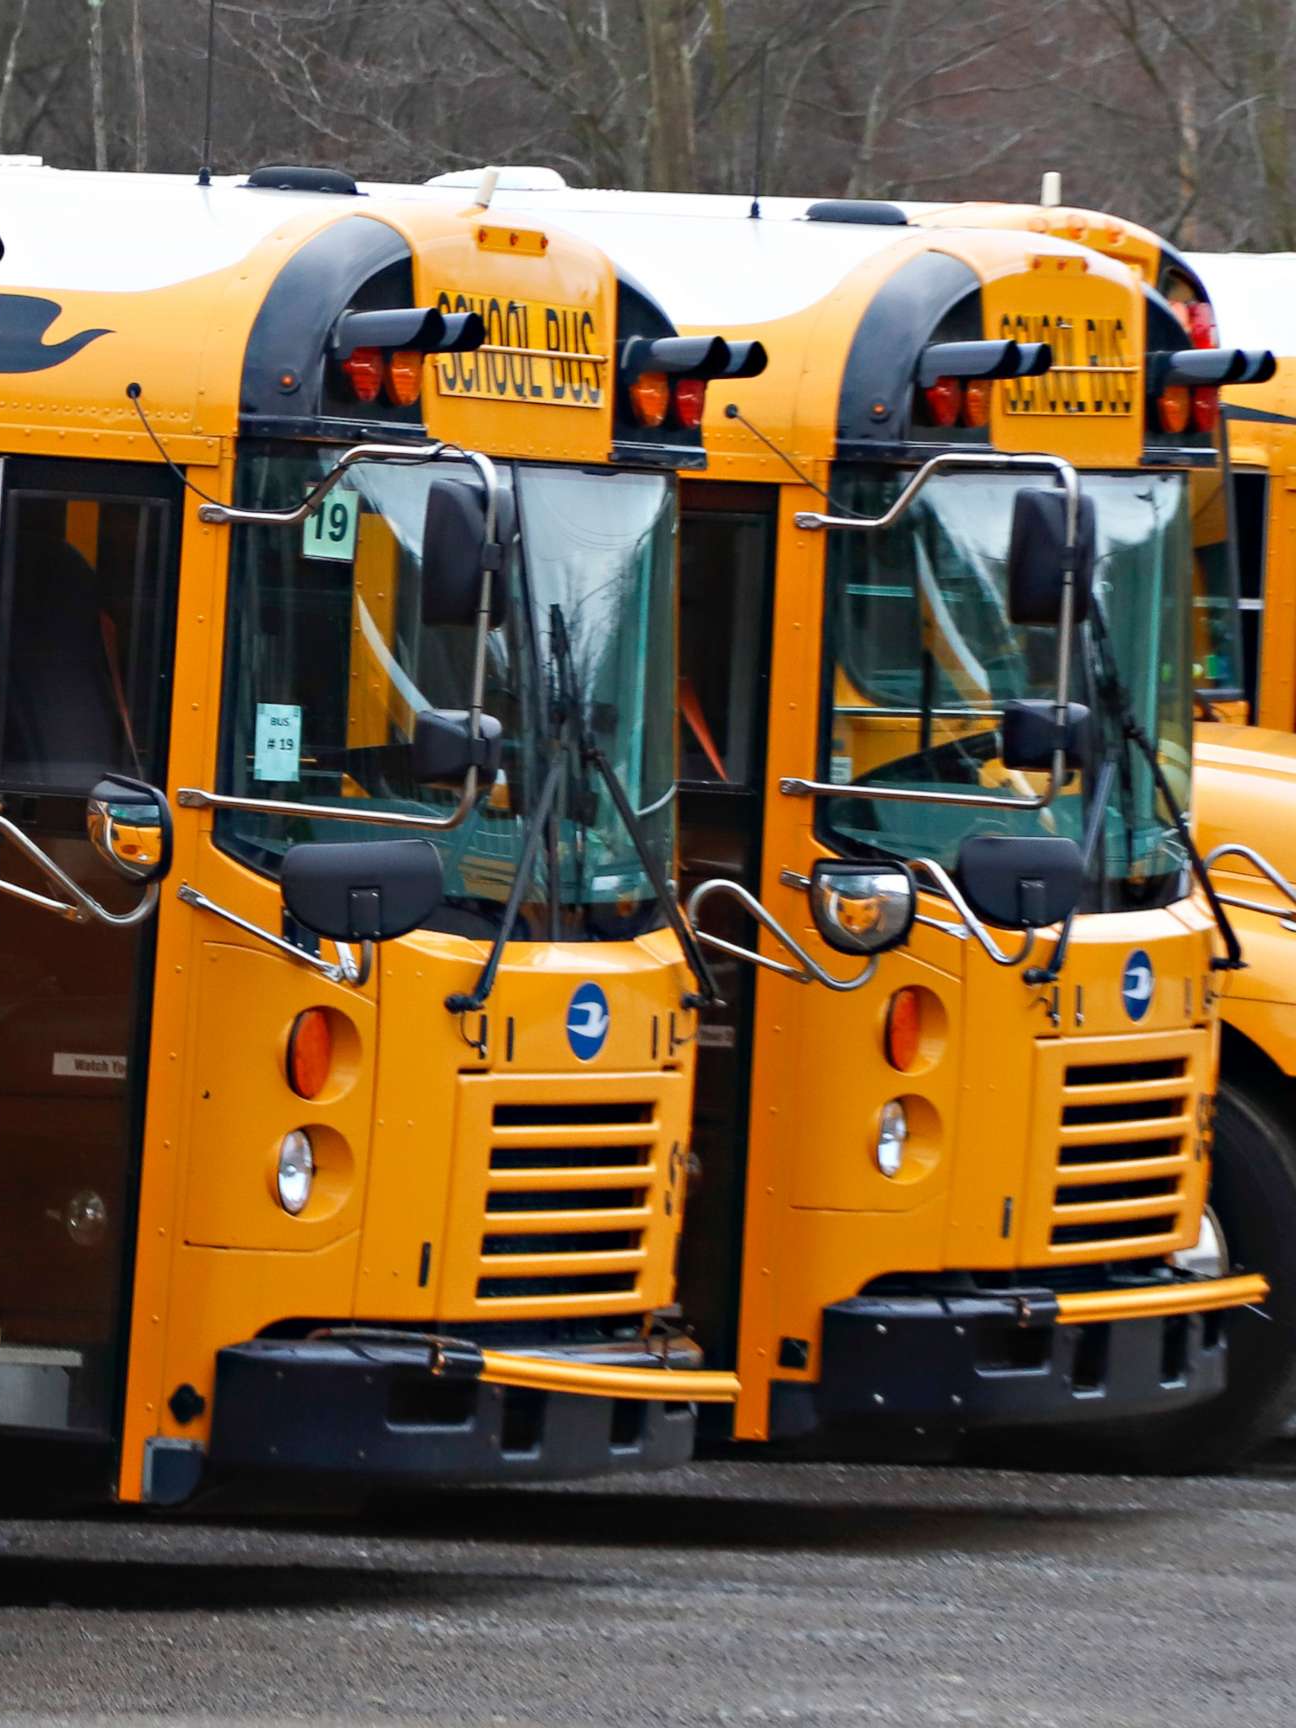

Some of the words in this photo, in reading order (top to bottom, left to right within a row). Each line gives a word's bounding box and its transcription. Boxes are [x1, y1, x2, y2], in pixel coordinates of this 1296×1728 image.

[546, 308, 601, 404] BUS
[311, 501, 349, 542] 19
[270, 716, 290, 727] BUS
